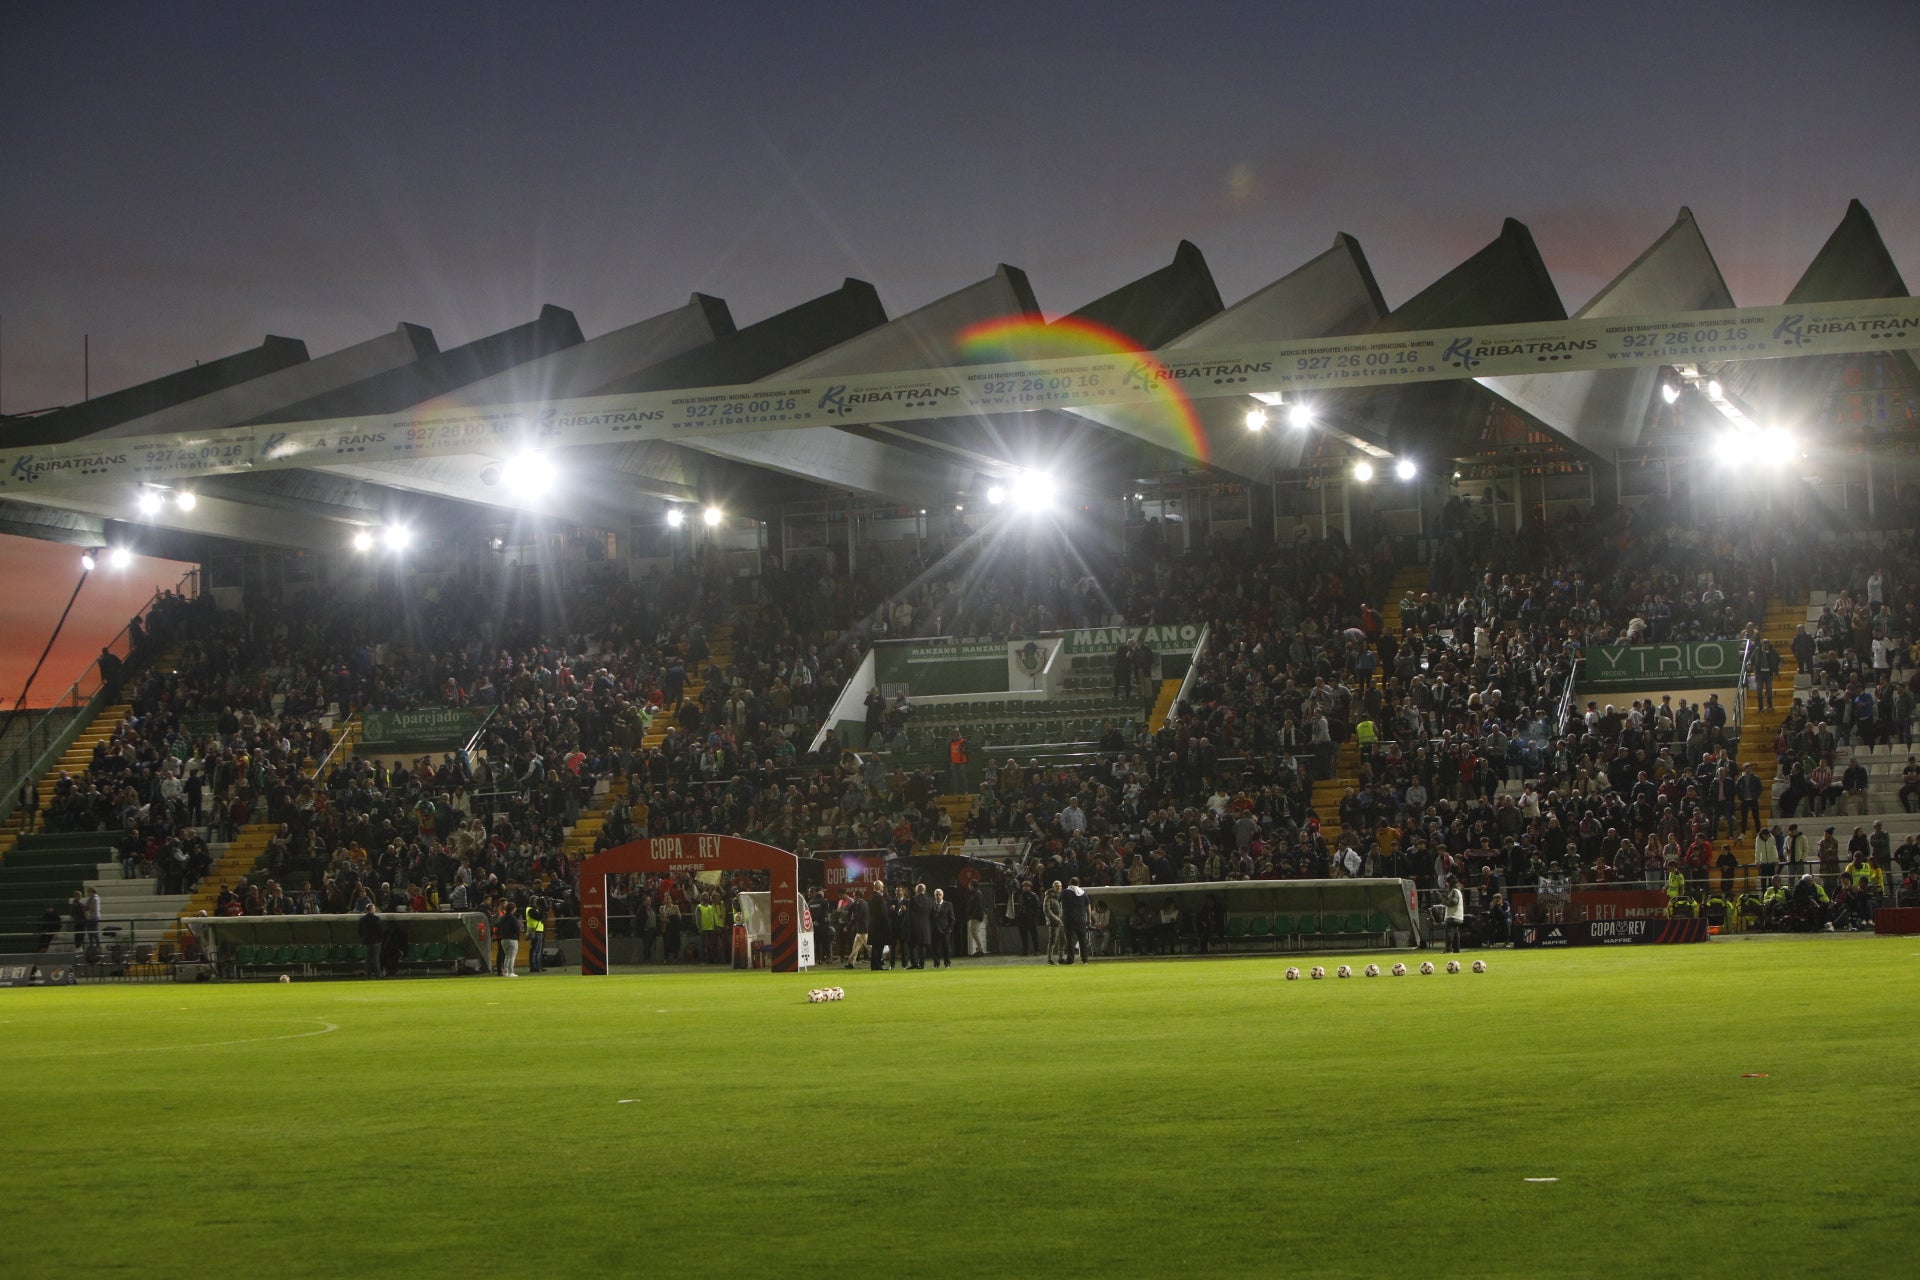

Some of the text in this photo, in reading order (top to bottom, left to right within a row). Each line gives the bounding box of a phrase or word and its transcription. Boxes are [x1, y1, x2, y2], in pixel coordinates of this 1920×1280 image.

[1622, 327, 1748, 348] 927 26 00 16
[1474, 339, 1598, 357] RIBATRANS
[1607, 342, 1766, 360] www.ribatrans.es
[1297, 350, 1418, 371] 927 26 00 16
[1154, 362, 1272, 381] RIBATRANS
[1281, 364, 1436, 382] www.ribatrans.es
[983, 374, 1100, 394] 927 26 00 16
[848, 386, 960, 404] RIBATRANS
[969, 388, 1116, 406] www.ribatrans.es
[686, 398, 796, 418] 927 26 00 16
[558, 410, 665, 427] RIBATRANS
[672, 412, 811, 429] www.ribatrans.es
[406, 421, 509, 441] 927 26 00 16
[146, 450, 175, 463] 927
[177, 448, 197, 461] 26
[200, 446, 220, 458] 00
[223, 444, 242, 457] 16
[35, 454, 128, 473] RIBATRANS
[1073, 625, 1197, 646] MANZANO
[911, 644, 1007, 655] MANZANO MANZANO
[392, 709, 460, 728] Aparejado
[651, 837, 683, 860] COPA
[698, 836, 720, 859] REY
[669, 863, 705, 871] MAPFRE
[863, 866, 880, 883] REY
[1625, 907, 1668, 917] MAPF
[1591, 921, 1646, 937] COPA REY
